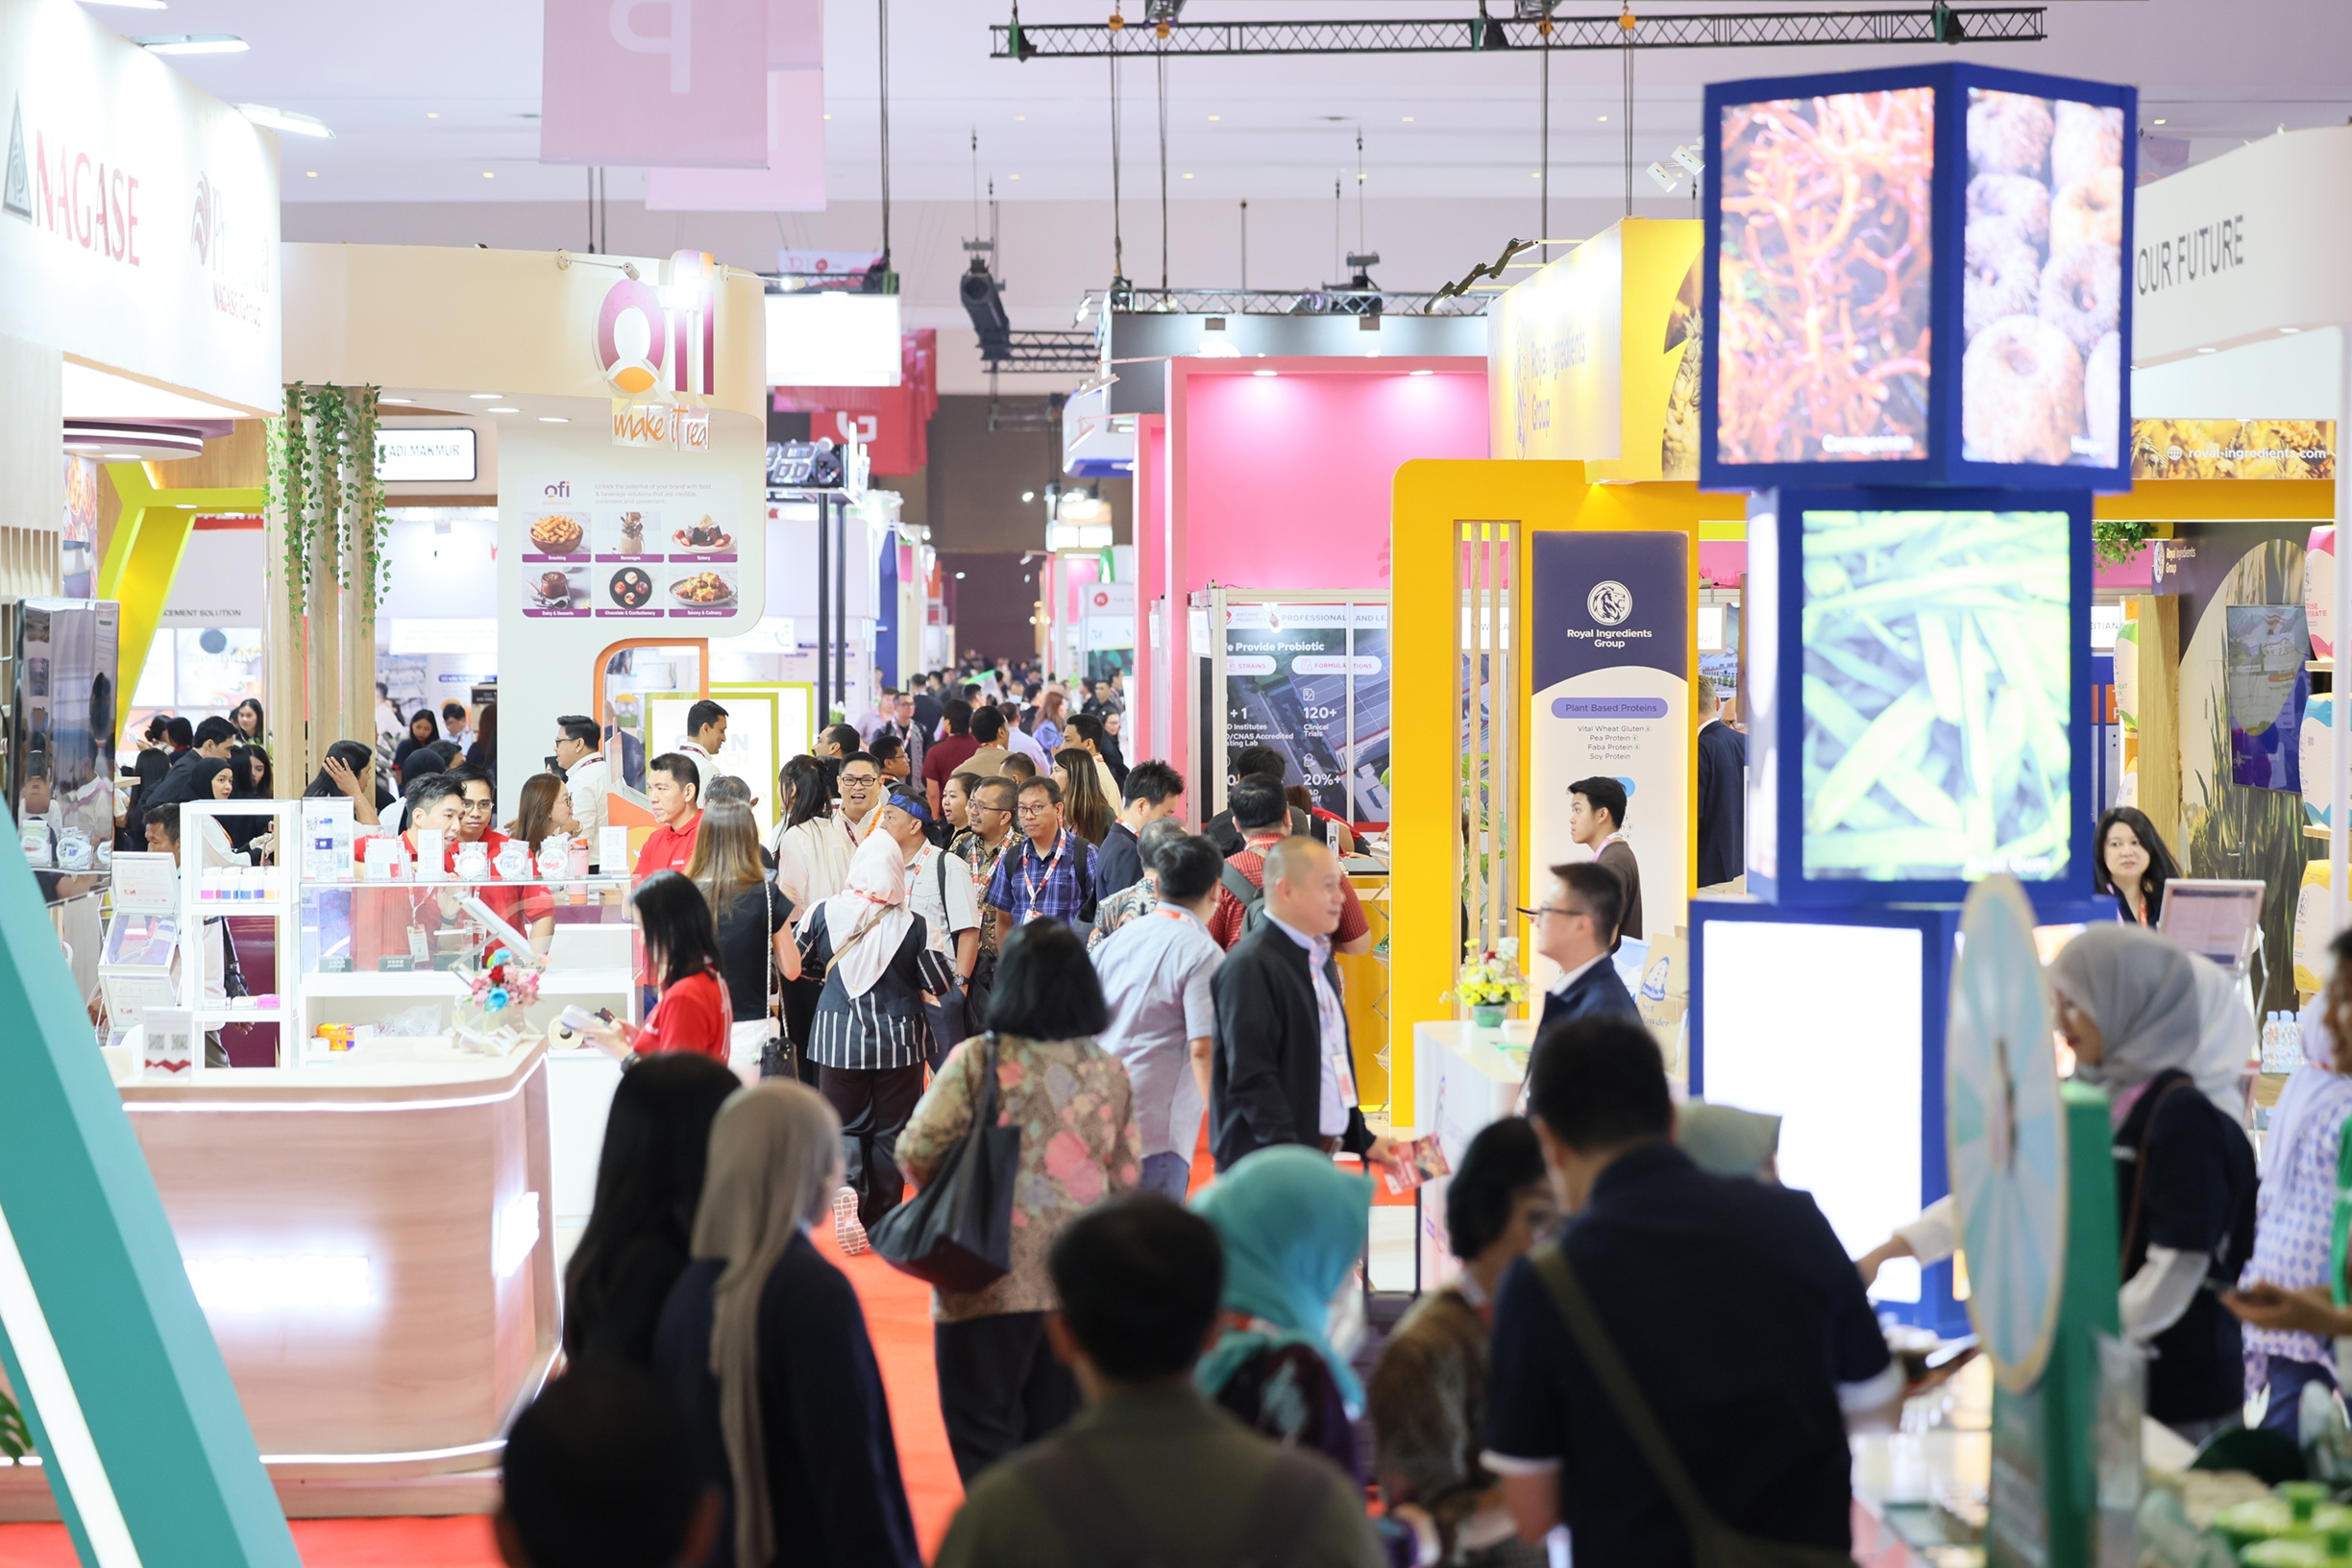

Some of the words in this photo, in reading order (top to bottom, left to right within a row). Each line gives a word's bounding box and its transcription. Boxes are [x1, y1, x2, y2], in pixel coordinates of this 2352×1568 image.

[37, 129, 140, 267] NAGASE
[2138, 240, 2172, 296] OUR
[2177, 214, 2243, 284] FUTURE
[614, 406, 665, 441] make
[389, 445, 406, 456] ADI
[410, 445, 460, 456] MAKMUR
[2189, 445, 2327, 459] royal-ingredients.com
[544, 480, 571, 499] ofi
[1567, 629, 1594, 640] Royal
[1596, 628, 1653, 640] Ingredients
[1236, 641, 1275, 651] Provide
[1278, 641, 1325, 651] Probiotic
[1594, 639, 1626, 649] Group
[1303, 707, 1337, 720] 120+
[1565, 703, 1588, 712] Plant
[1591, 703, 1618, 712] Based
[1621, 703, 1657, 712] Proteins
[1303, 773, 1341, 786] 20%+
